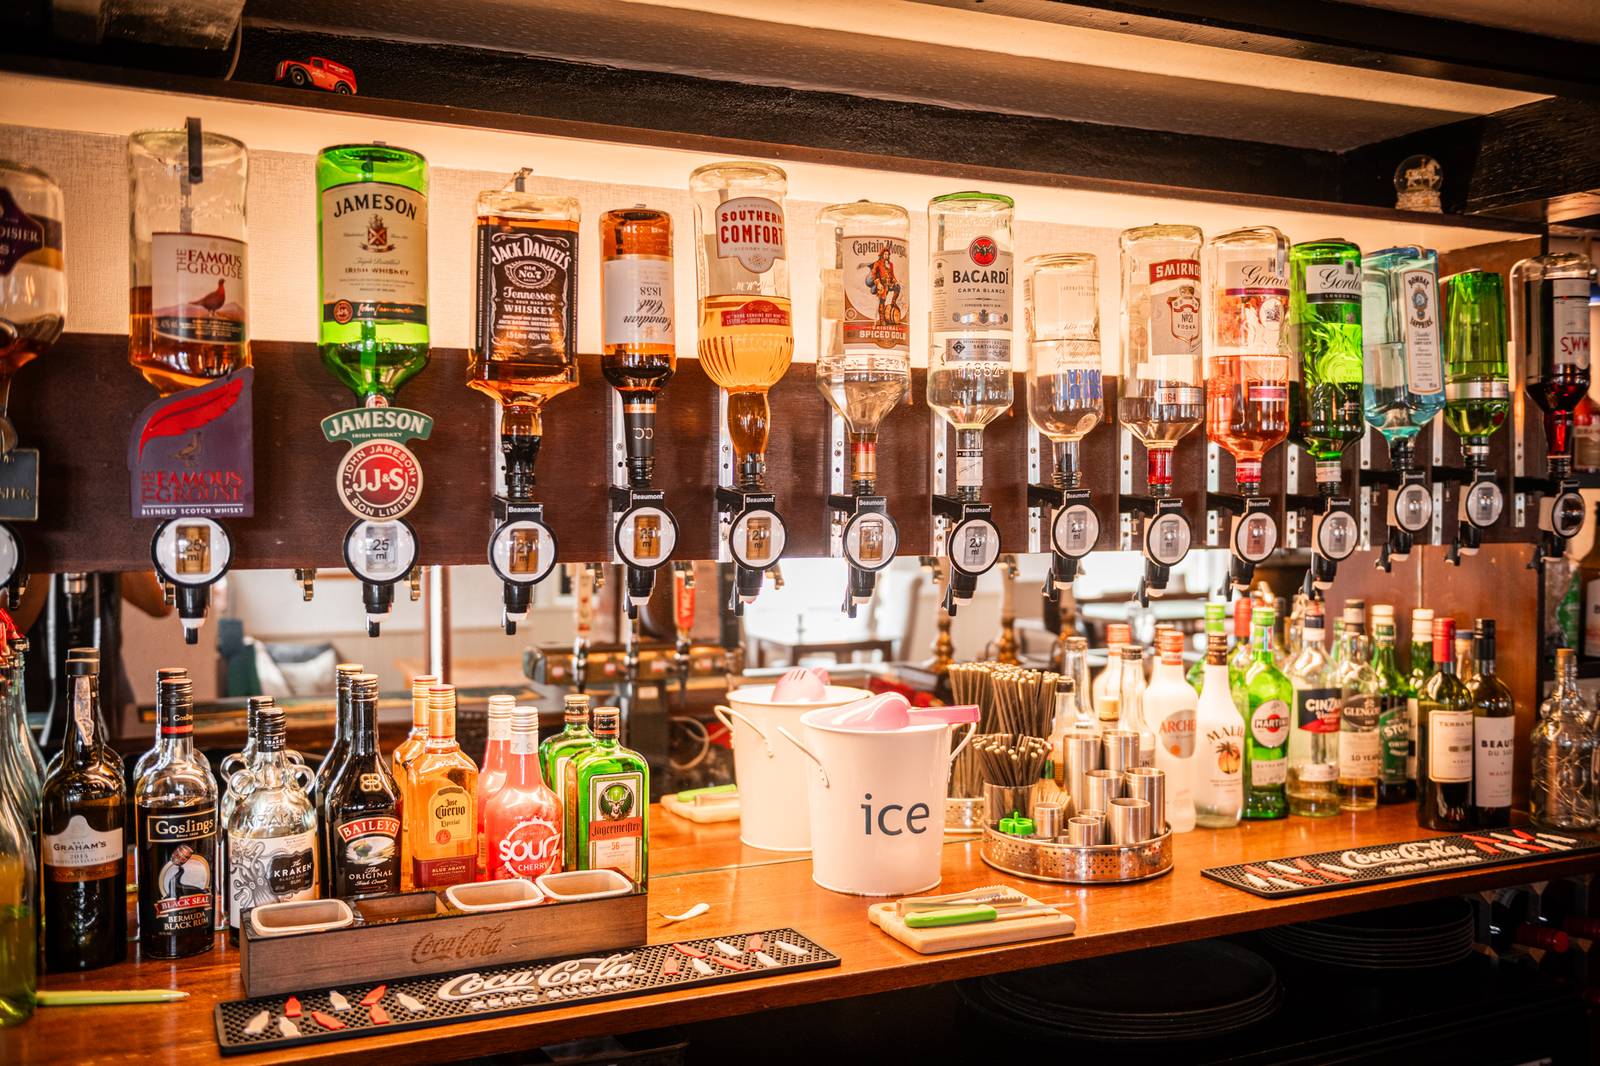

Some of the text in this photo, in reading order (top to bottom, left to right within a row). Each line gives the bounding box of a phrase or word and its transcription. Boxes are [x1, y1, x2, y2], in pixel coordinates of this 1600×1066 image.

[334, 193, 417, 220] JAMESON
[720, 224, 784, 246] COMFORT
[491, 241, 523, 265] JACK
[852, 240, 885, 256] Captain
[188, 249, 242, 267] FAMOUS
[187, 262, 243, 279] GROUSE
[503, 286, 557, 301] Tennessee
[504, 304, 556, 315] WHISKEY
[859, 330, 890, 339] SPICED
[329, 411, 427, 437] JAMESON
[344, 445, 417, 479] JOHN JAMESON
[156, 470, 244, 487] FAMOUS
[352, 467, 405, 492] JJ&S
[155, 486, 243, 503] GROUSE
[352, 498, 375, 516] SON
[378, 485, 417, 517] LIMITED
[141, 507, 177, 516] BLENDED
[180, 507, 212, 515] SCOTCH
[965, 506, 991, 514] Beaumont
[373, 538, 389, 551] 25
[187, 552, 199, 561] ml
[375, 552, 387, 560] ml
[435, 805, 466, 820] Cuervo
[860, 793, 930, 836] ice
[155, 819, 214, 835] Goslings
[342, 820, 398, 838] BAILEYS
[53, 841, 107, 851] GRAHAM'S
[1341, 839, 1477, 869] Coca-Cola
[274, 862, 312, 878] KRAKEN
[348, 869, 393, 880] ORIGINAL
[161, 896, 209, 910] BLACK SEAL
[163, 917, 209, 931] BLACK RUM
[168, 911, 206, 922] BERMUDA
[438, 951, 642, 1001] Coca-Cola
[469, 980, 632, 1011] ZERO SUGAR
